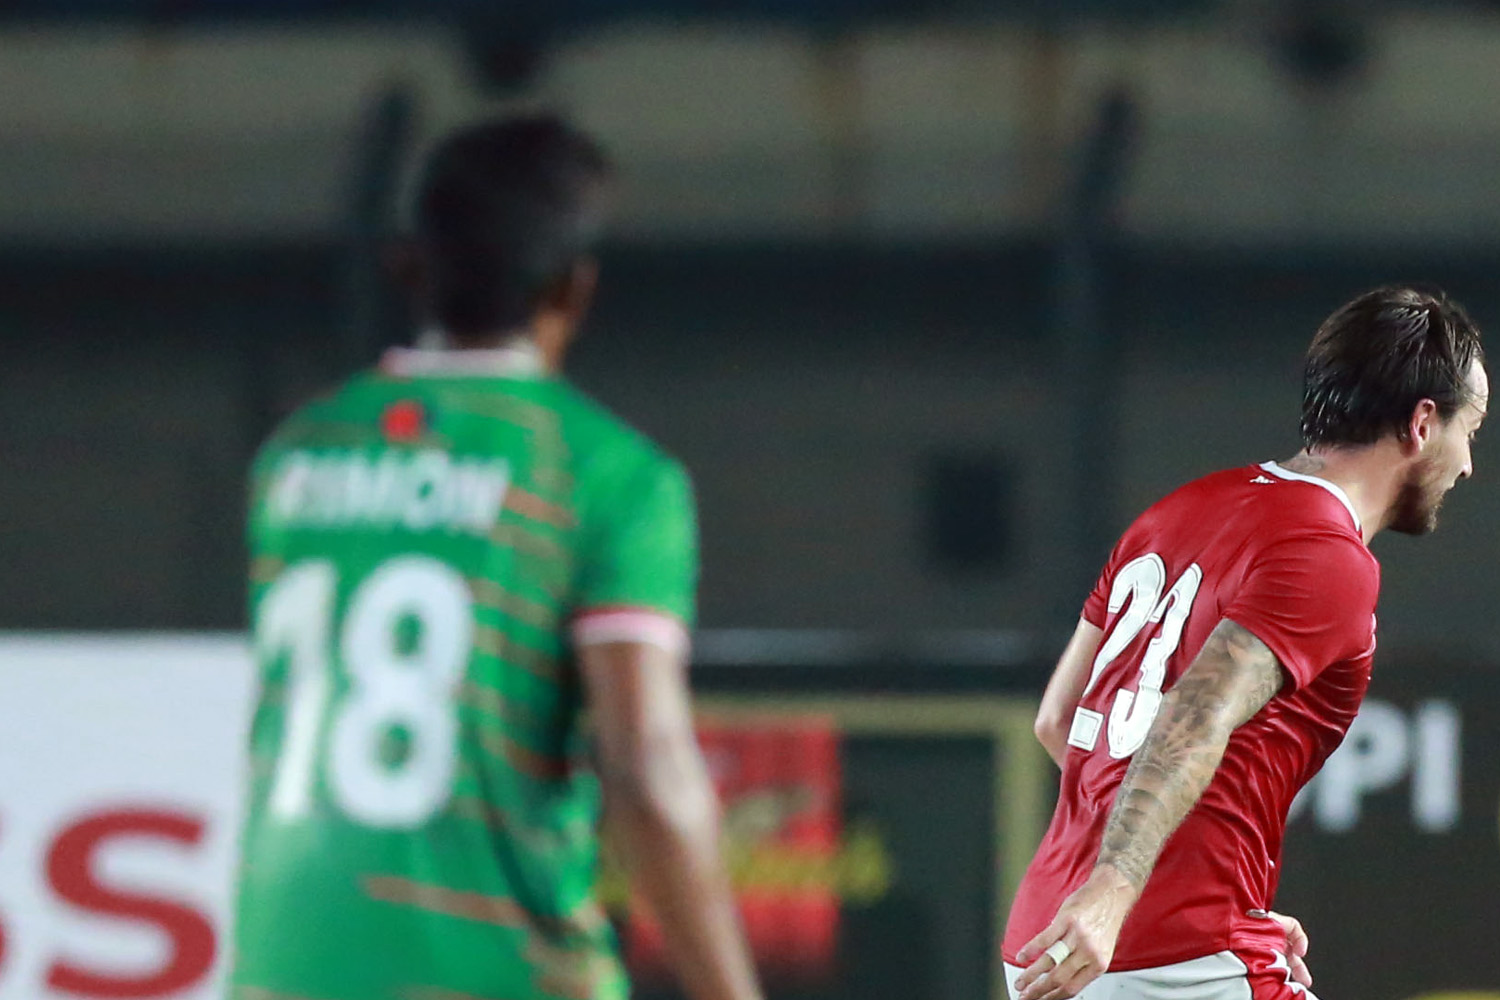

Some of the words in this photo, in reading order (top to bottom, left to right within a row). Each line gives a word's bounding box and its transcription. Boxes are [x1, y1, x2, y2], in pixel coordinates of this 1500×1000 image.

[256, 552, 475, 830] 18
[1067, 552, 1203, 760] 23
[1287, 700, 1461, 832] PI
